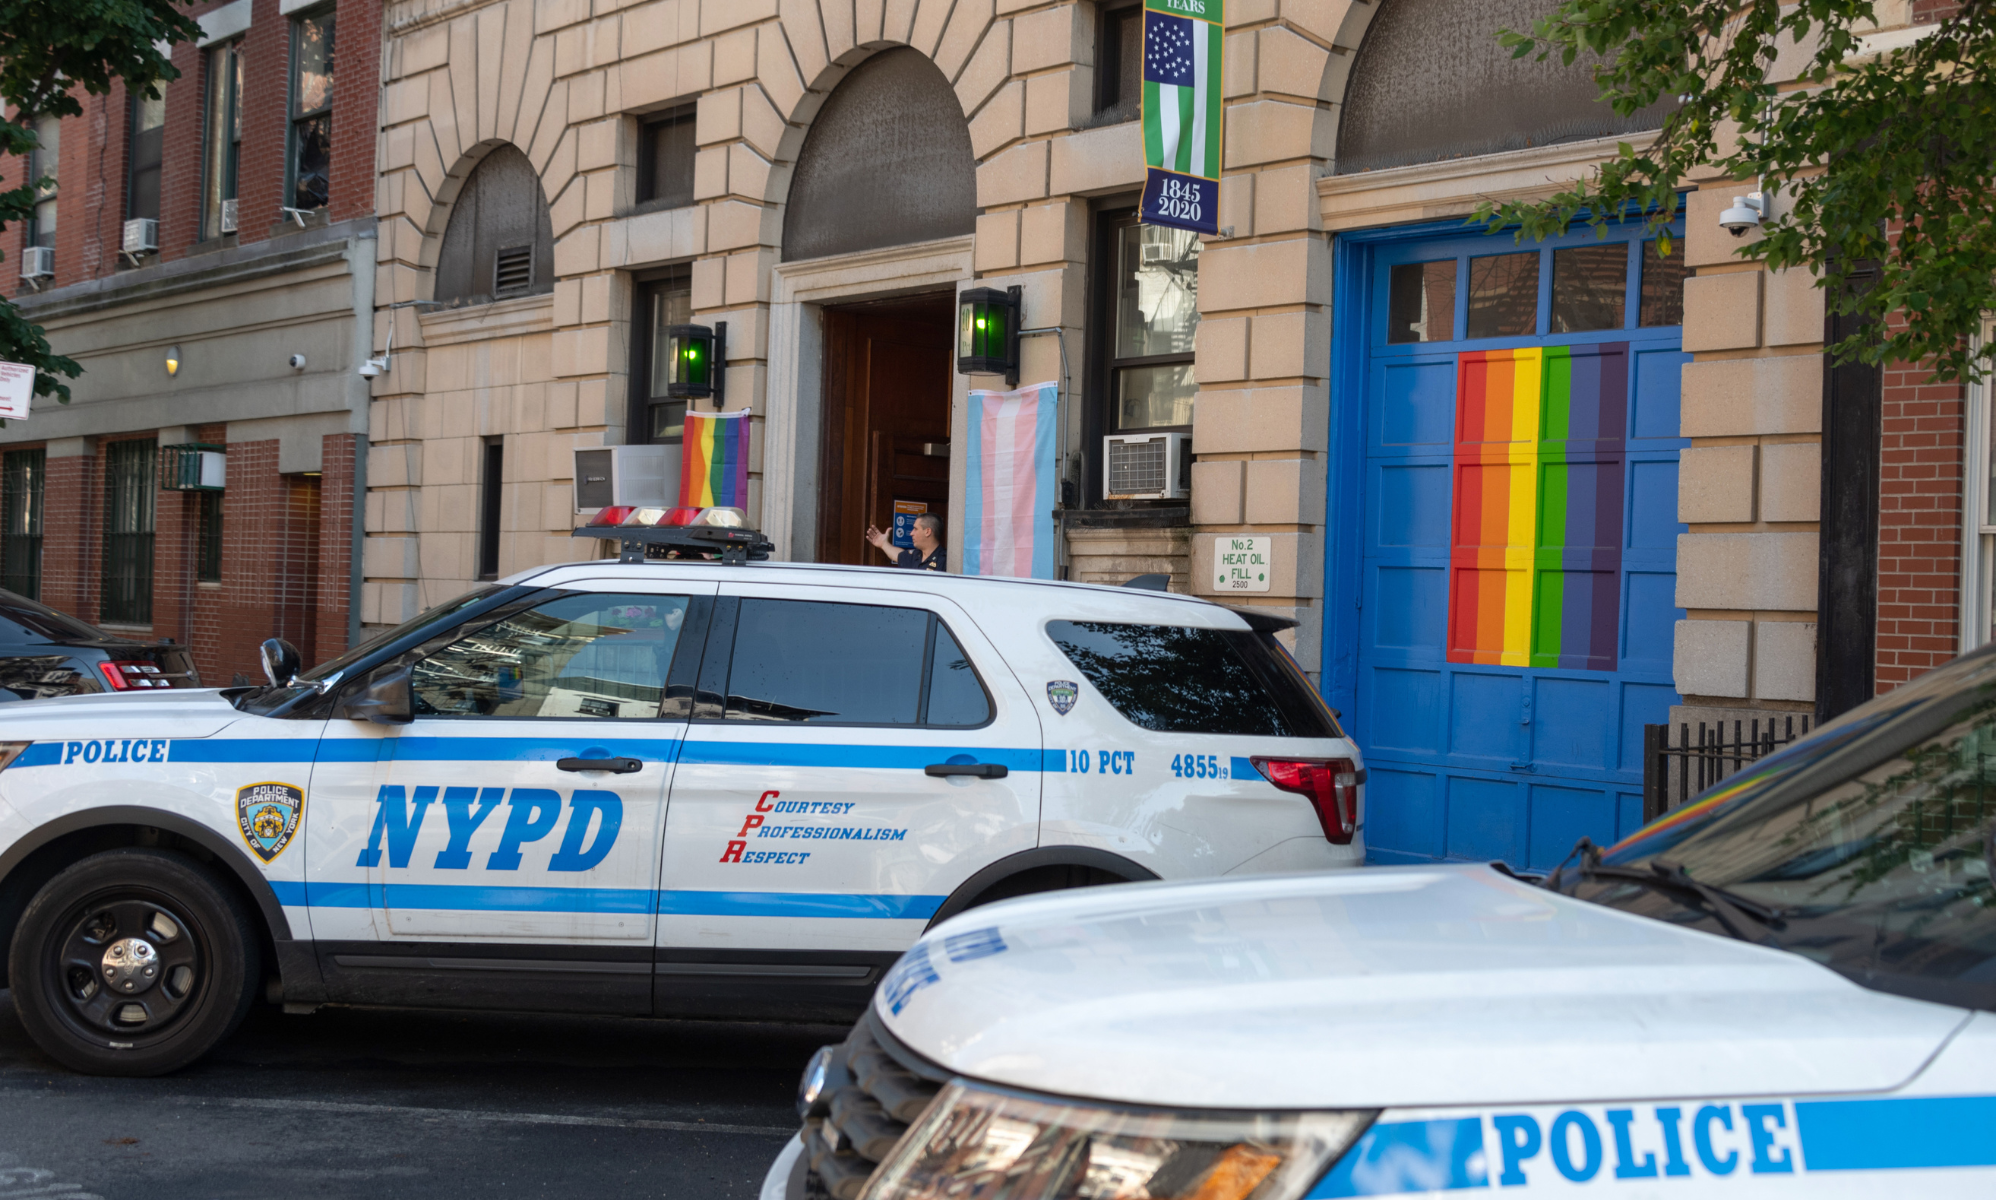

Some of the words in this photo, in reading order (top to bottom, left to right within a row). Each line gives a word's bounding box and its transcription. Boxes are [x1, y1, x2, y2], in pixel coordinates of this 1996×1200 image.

[1167, 0, 1206, 14] YEARS
[1160, 178, 1201, 203] 1845
[1158, 196, 1202, 222] 2020
[1222, 553, 1248, 565] HEAT
[1250, 553, 1265, 565] OIL
[1231, 568, 1252, 579] FILL
[1232, 580, 1248, 588] 2500
[64, 740, 167, 765] POLICE
[1071, 749, 1090, 774] 10
[1098, 750, 1135, 775] PCT
[240, 793, 300, 809] DEPARTMENT
[253, 785, 289, 796] POLICE
[241, 817, 253, 836] CITY
[250, 838, 260, 849] OF
[272, 836, 288, 853] NEW
[286, 812, 300, 834] YORK
[356, 784, 624, 872] NYPD
[1493, 1102, 1795, 1183] POLICE
